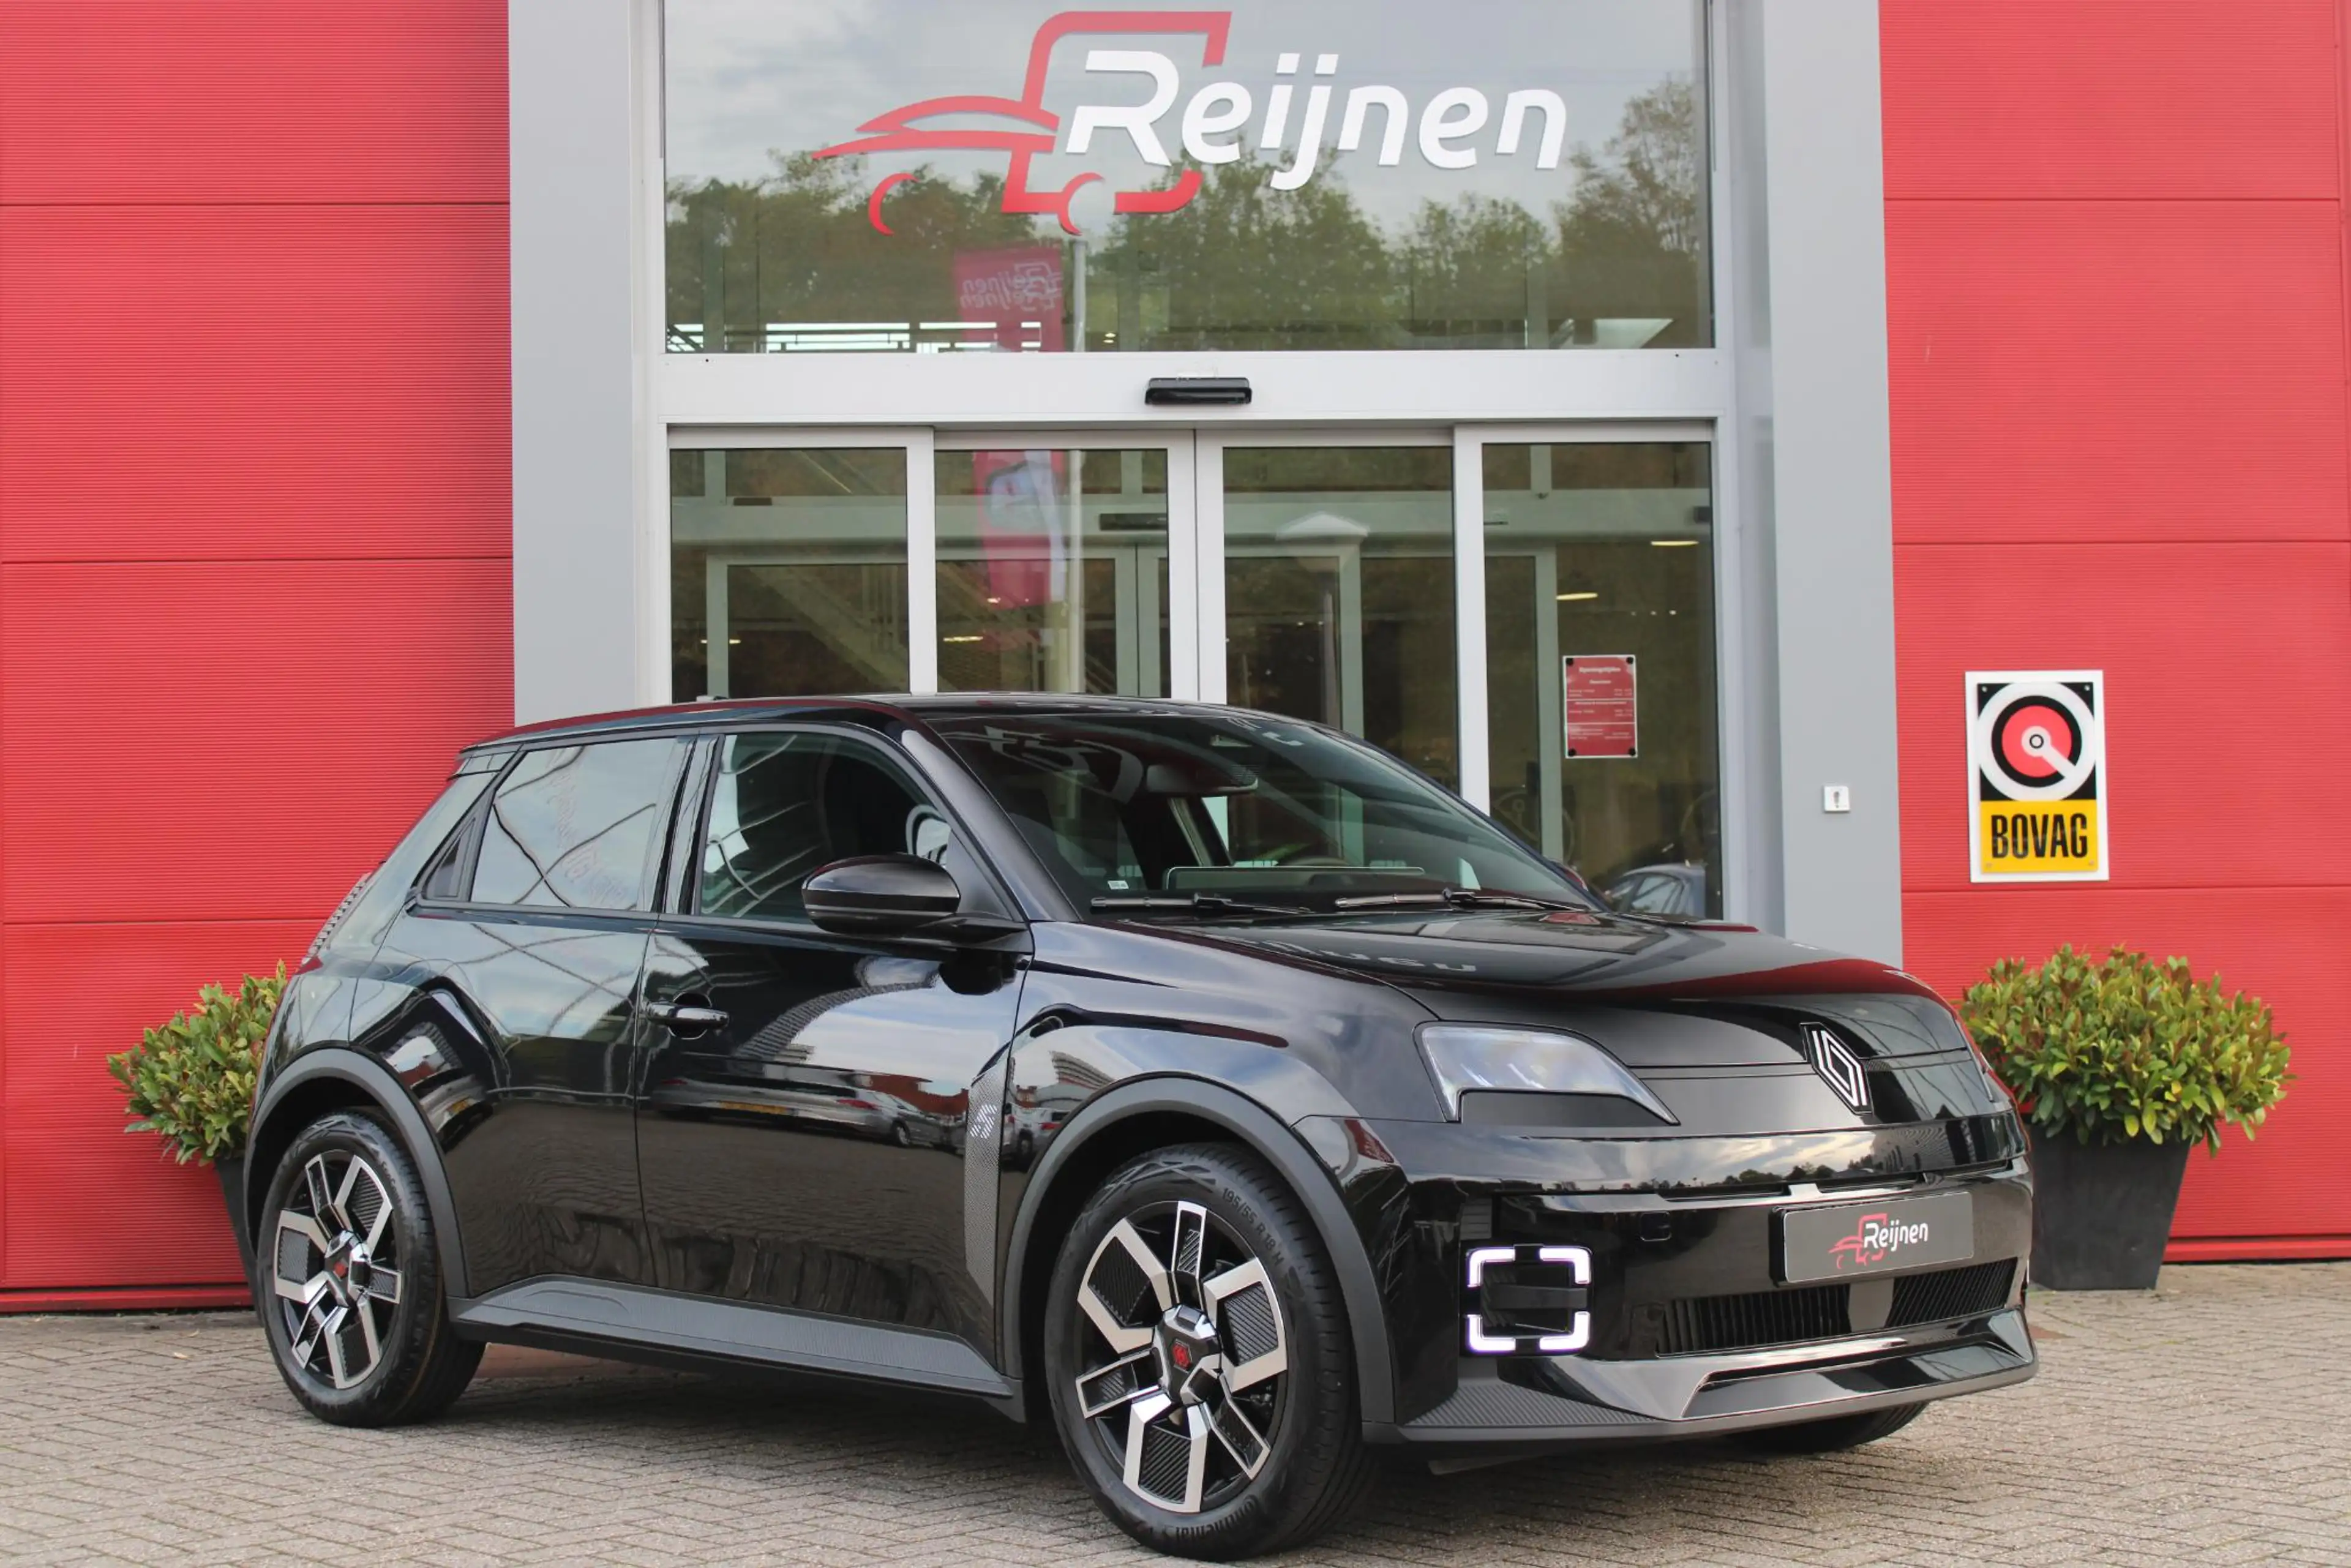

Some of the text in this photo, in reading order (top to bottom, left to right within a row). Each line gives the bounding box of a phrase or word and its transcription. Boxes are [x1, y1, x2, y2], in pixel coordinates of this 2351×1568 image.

[1065, 50, 1567, 190] Reijnen
[1991, 813, 2088, 859] BOVAG
[1222, 1188, 1258, 1224] 195/55
[1256, 1223, 1266, 1236] R
[1264, 1234, 1277, 1251] 18
[1864, 1219, 1929, 1251] Reijnen
